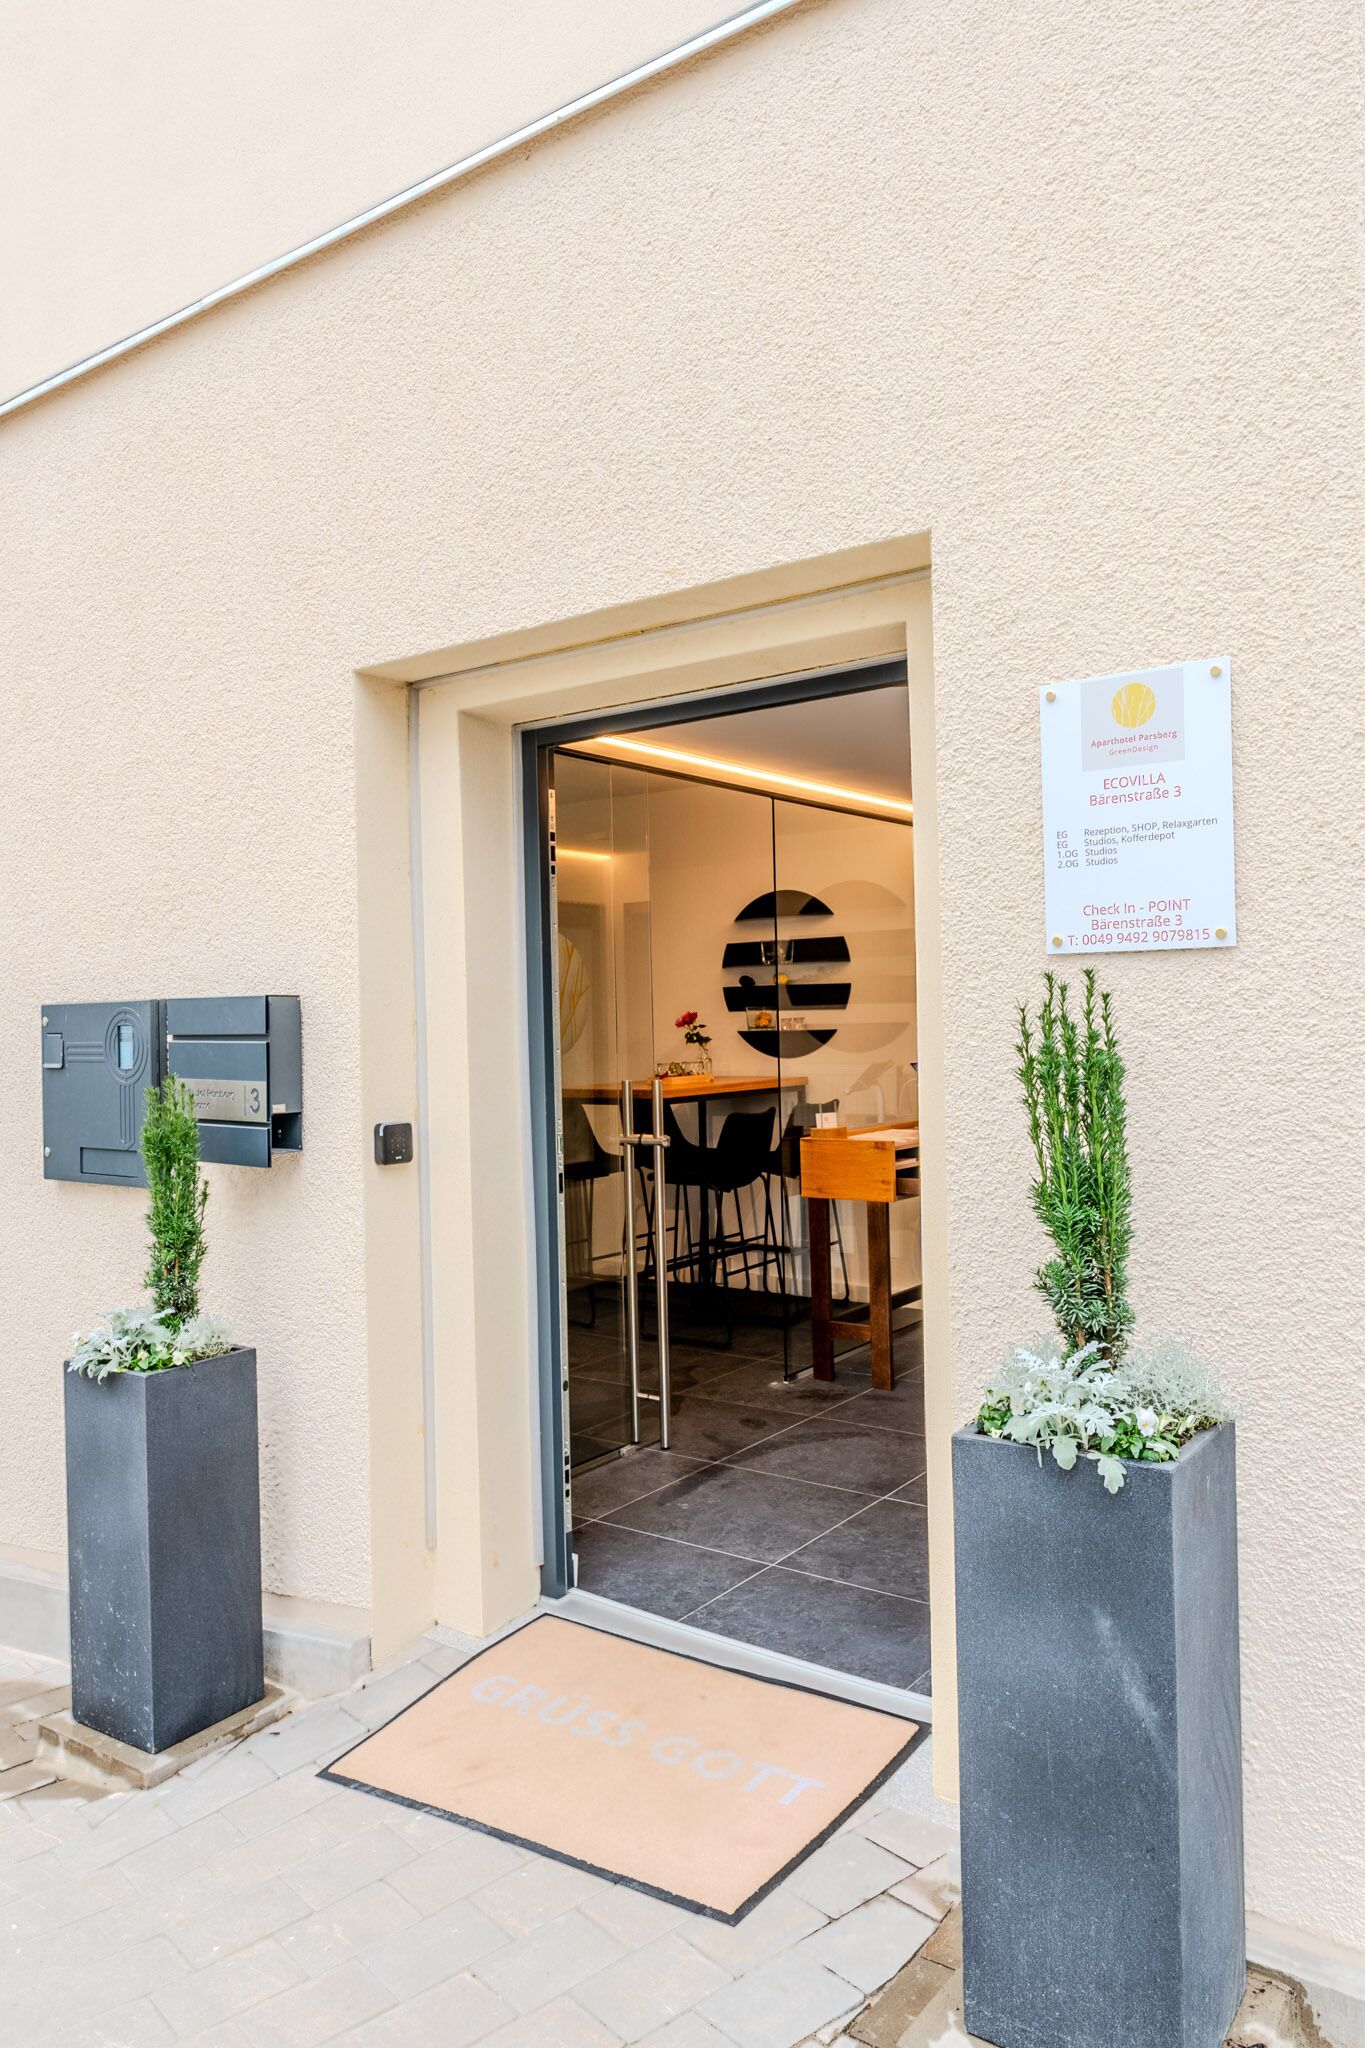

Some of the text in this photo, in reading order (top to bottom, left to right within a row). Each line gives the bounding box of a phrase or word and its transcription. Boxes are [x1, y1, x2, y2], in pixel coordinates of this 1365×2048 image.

[1091, 730, 1178, 748] Aparthotel Parsberg
[1109, 744, 1159, 756] GreenDesign
[1103, 772, 1166, 790] ECOVILLA
[1090, 786, 1182, 806] Bärenstraße 3
[1057, 817, 1218, 839] EG Rezeption, SHOP, Relaxgarten
[1057, 831, 1175, 849] EG Studios, Kofferdepot
[1058, 847, 1118, 858] 1.OG Studios
[1058, 857, 1118, 869] 2.OG Studios
[1083, 903, 1120, 916] Check
[1124, 903, 1136, 914] In
[1149, 899, 1191, 912] POINT
[1092, 914, 1182, 930] Bärenstraße 3
[1067, 929, 1210, 946] T: 0049 9492 9079815
[250, 1088, 260, 1114] 3
[470, 1674, 827, 1806] GRÜSS GOTT
